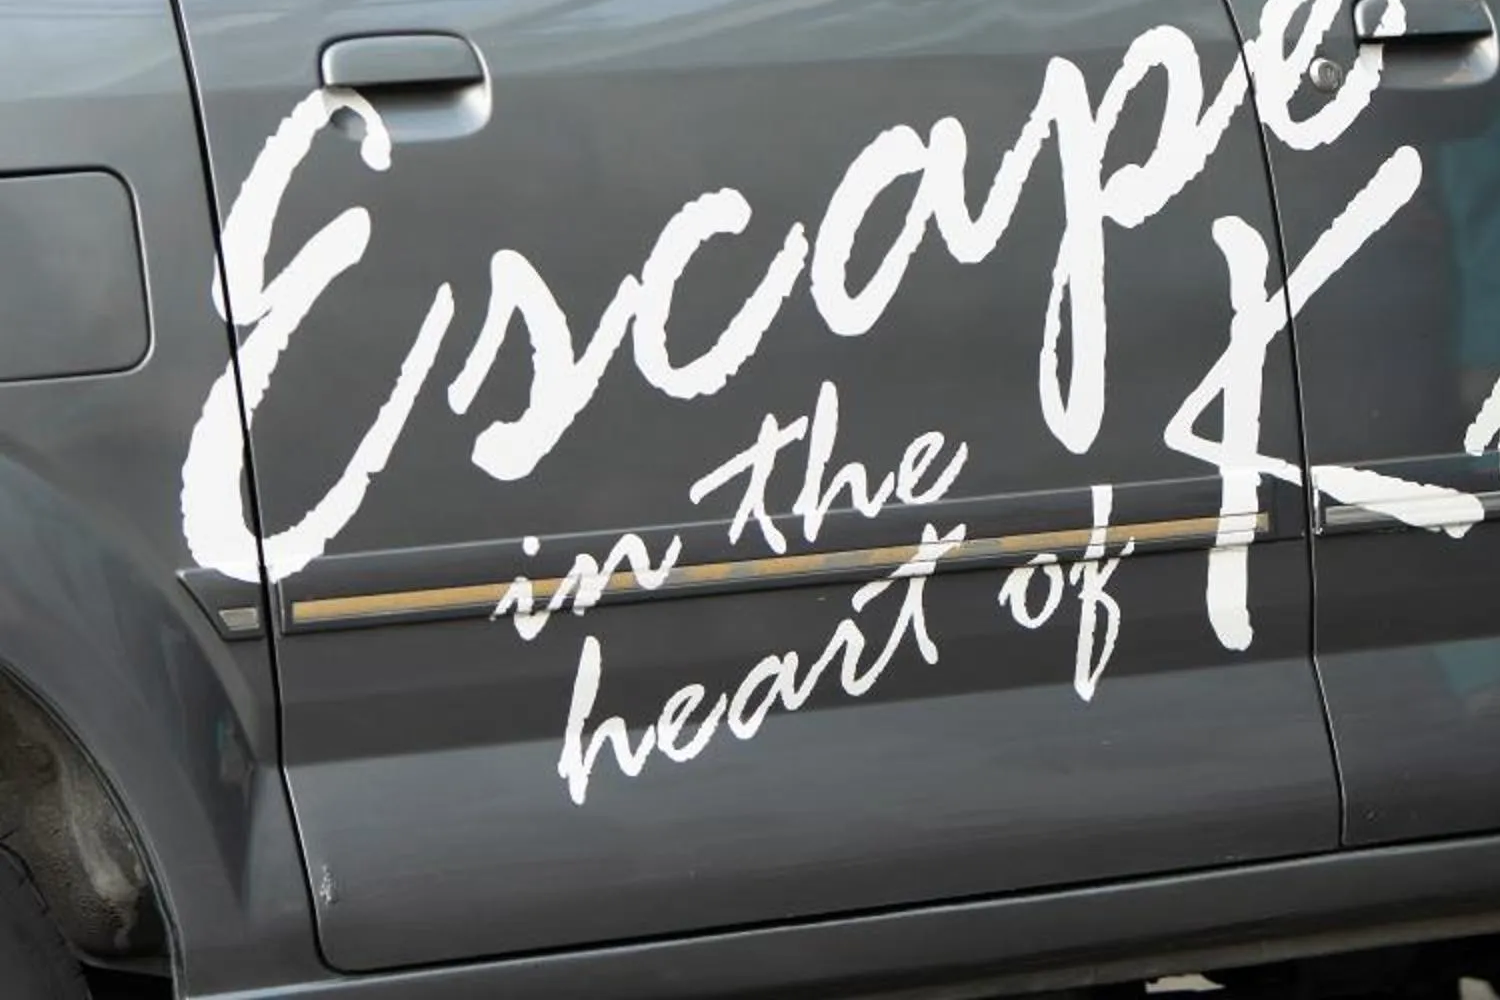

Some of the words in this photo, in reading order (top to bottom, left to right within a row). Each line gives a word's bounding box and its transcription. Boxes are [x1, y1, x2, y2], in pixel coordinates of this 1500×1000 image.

[490, 533, 682, 642] in
[688, 380, 969, 556] the
[556, 520, 967, 806] heart
[998, 483, 1137, 702] of
